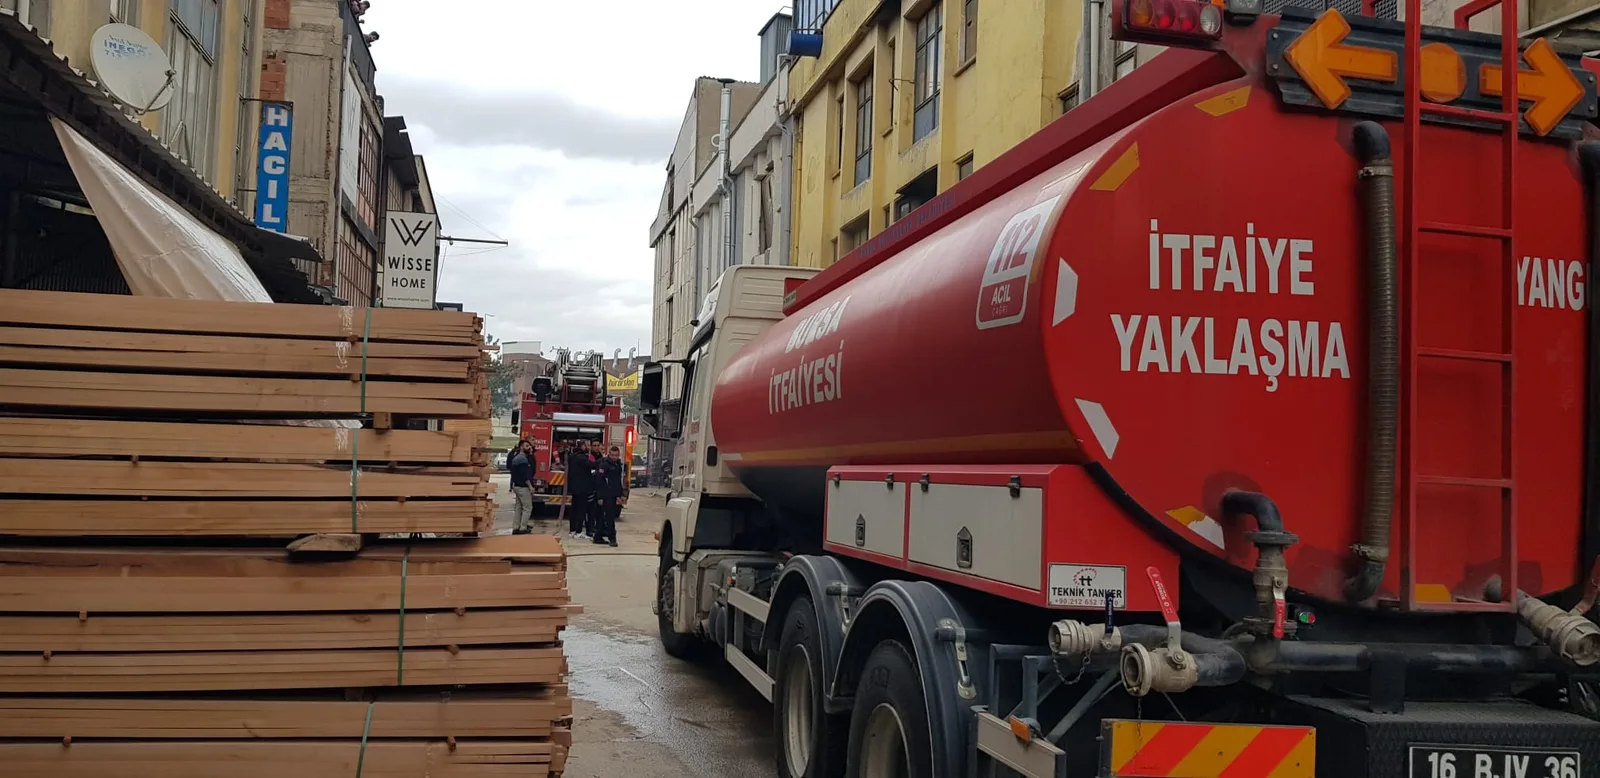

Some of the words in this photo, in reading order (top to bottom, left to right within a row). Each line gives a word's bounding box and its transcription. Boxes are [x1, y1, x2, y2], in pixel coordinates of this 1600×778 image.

[262, 106, 289, 231] HACIL
[992, 213, 1042, 274] 112
[1149, 218, 1315, 296] İTFAİYE
[391, 277, 426, 289] HOME
[784, 294, 851, 354] BURSA
[1109, 313, 1351, 392] YAKLAŞMA
[768, 339, 844, 415] İTFAİYESİ
[1051, 586, 1085, 597] TEKNİK
[1087, 588, 1122, 598] TANKER
[1428, 752, 1456, 778] 16
[1544, 756, 1576, 778] 36
